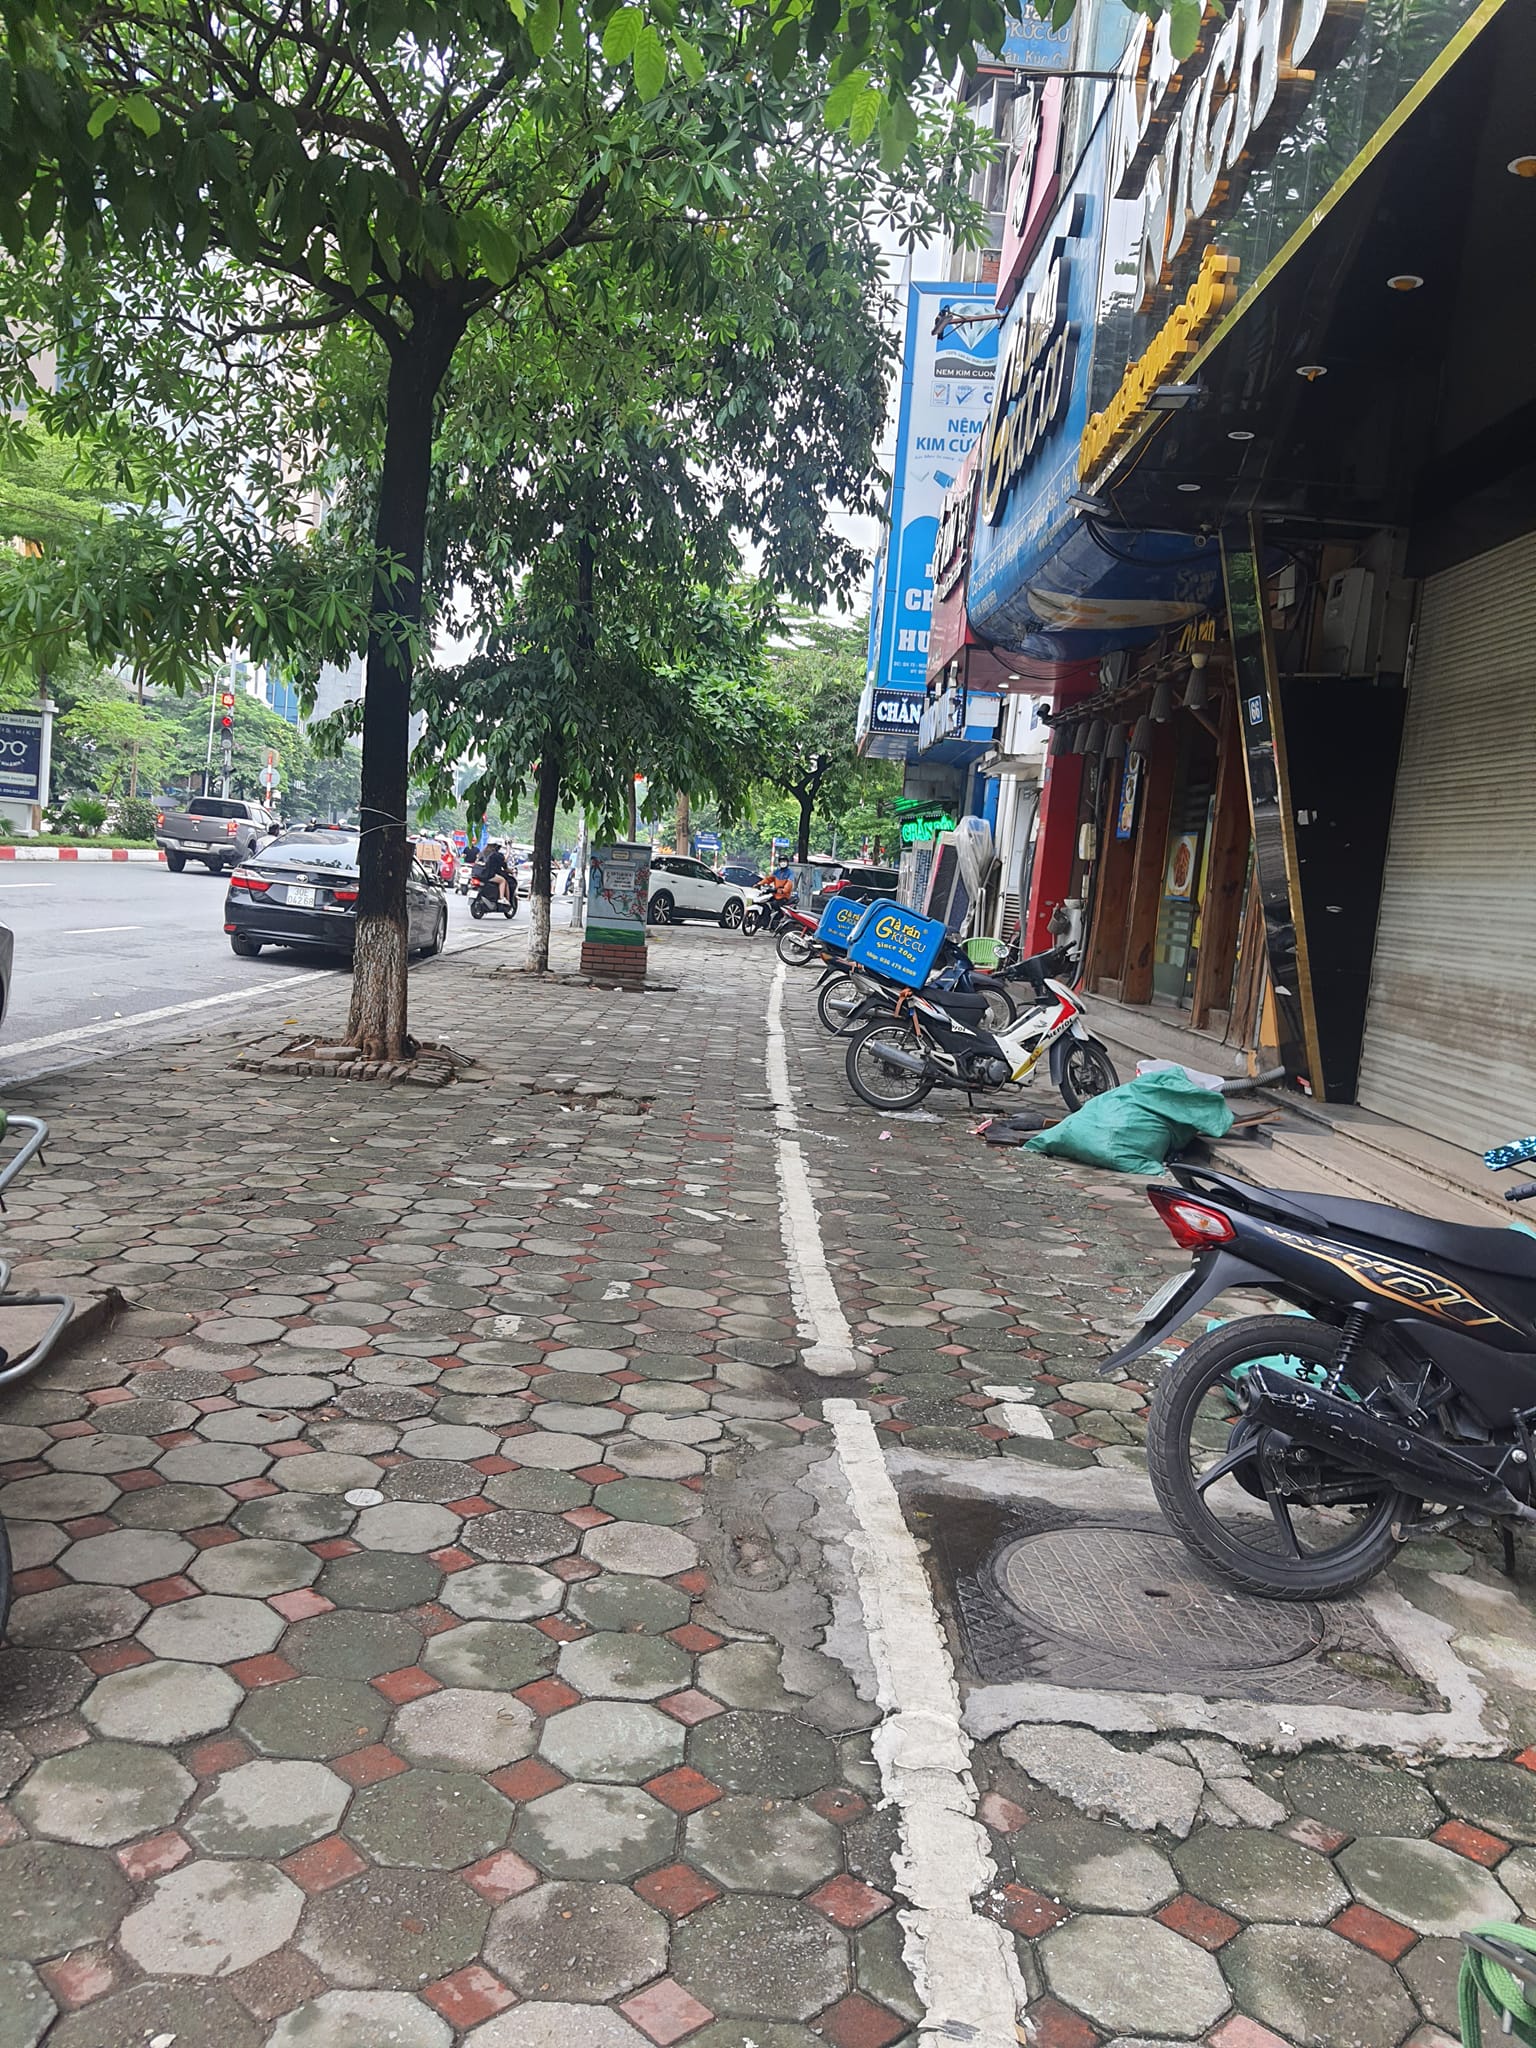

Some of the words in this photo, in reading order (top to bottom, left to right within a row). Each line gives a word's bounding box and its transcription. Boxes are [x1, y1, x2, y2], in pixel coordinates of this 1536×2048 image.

[955, 369, 971, 377] KIM
[915, 437, 945, 451] KIM
[876, 698, 923, 724] CHĂN
[1250, 700, 1261, 720] 66
[875, 916, 902, 938] Gà
